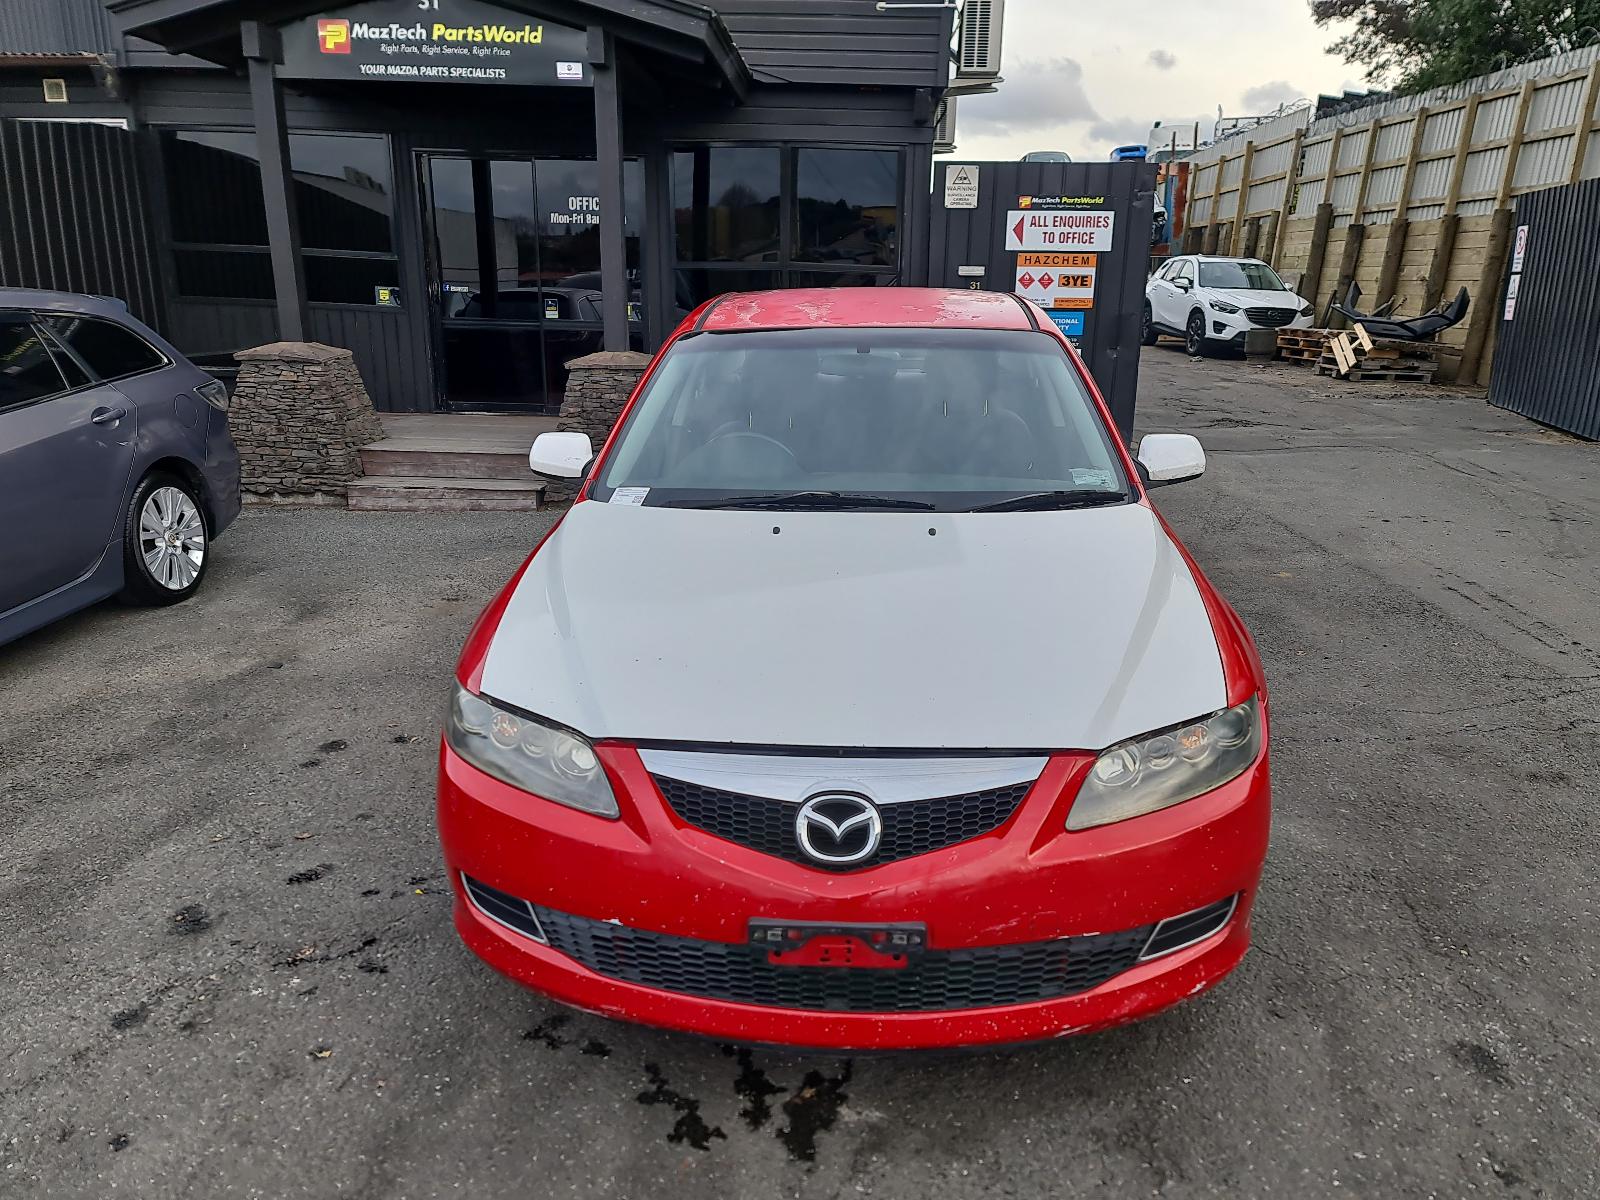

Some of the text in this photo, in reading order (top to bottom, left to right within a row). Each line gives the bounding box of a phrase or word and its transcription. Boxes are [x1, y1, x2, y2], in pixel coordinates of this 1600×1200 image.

[351, 22, 427, 40] MazTech
[431, 23, 543, 44] PartsWorld
[380, 43, 511, 57] Right Parts, Right Service, Right Price
[360, 64, 506, 78] YOUR MAZDA PARTS SPECIALISTS
[568, 196, 600, 211] OFFIC
[1061, 196, 1104, 204] PartsWorld
[550, 212, 584, 224] Mon-Fri
[1029, 215, 1110, 229] ALL ENQUIRIES
[1042, 231, 1095, 245] TO OFFICE
[1023, 255, 1090, 265] HAZCHEM
[970, 281, 981, 290] 31
[1061, 275, 1089, 287] 3YE
